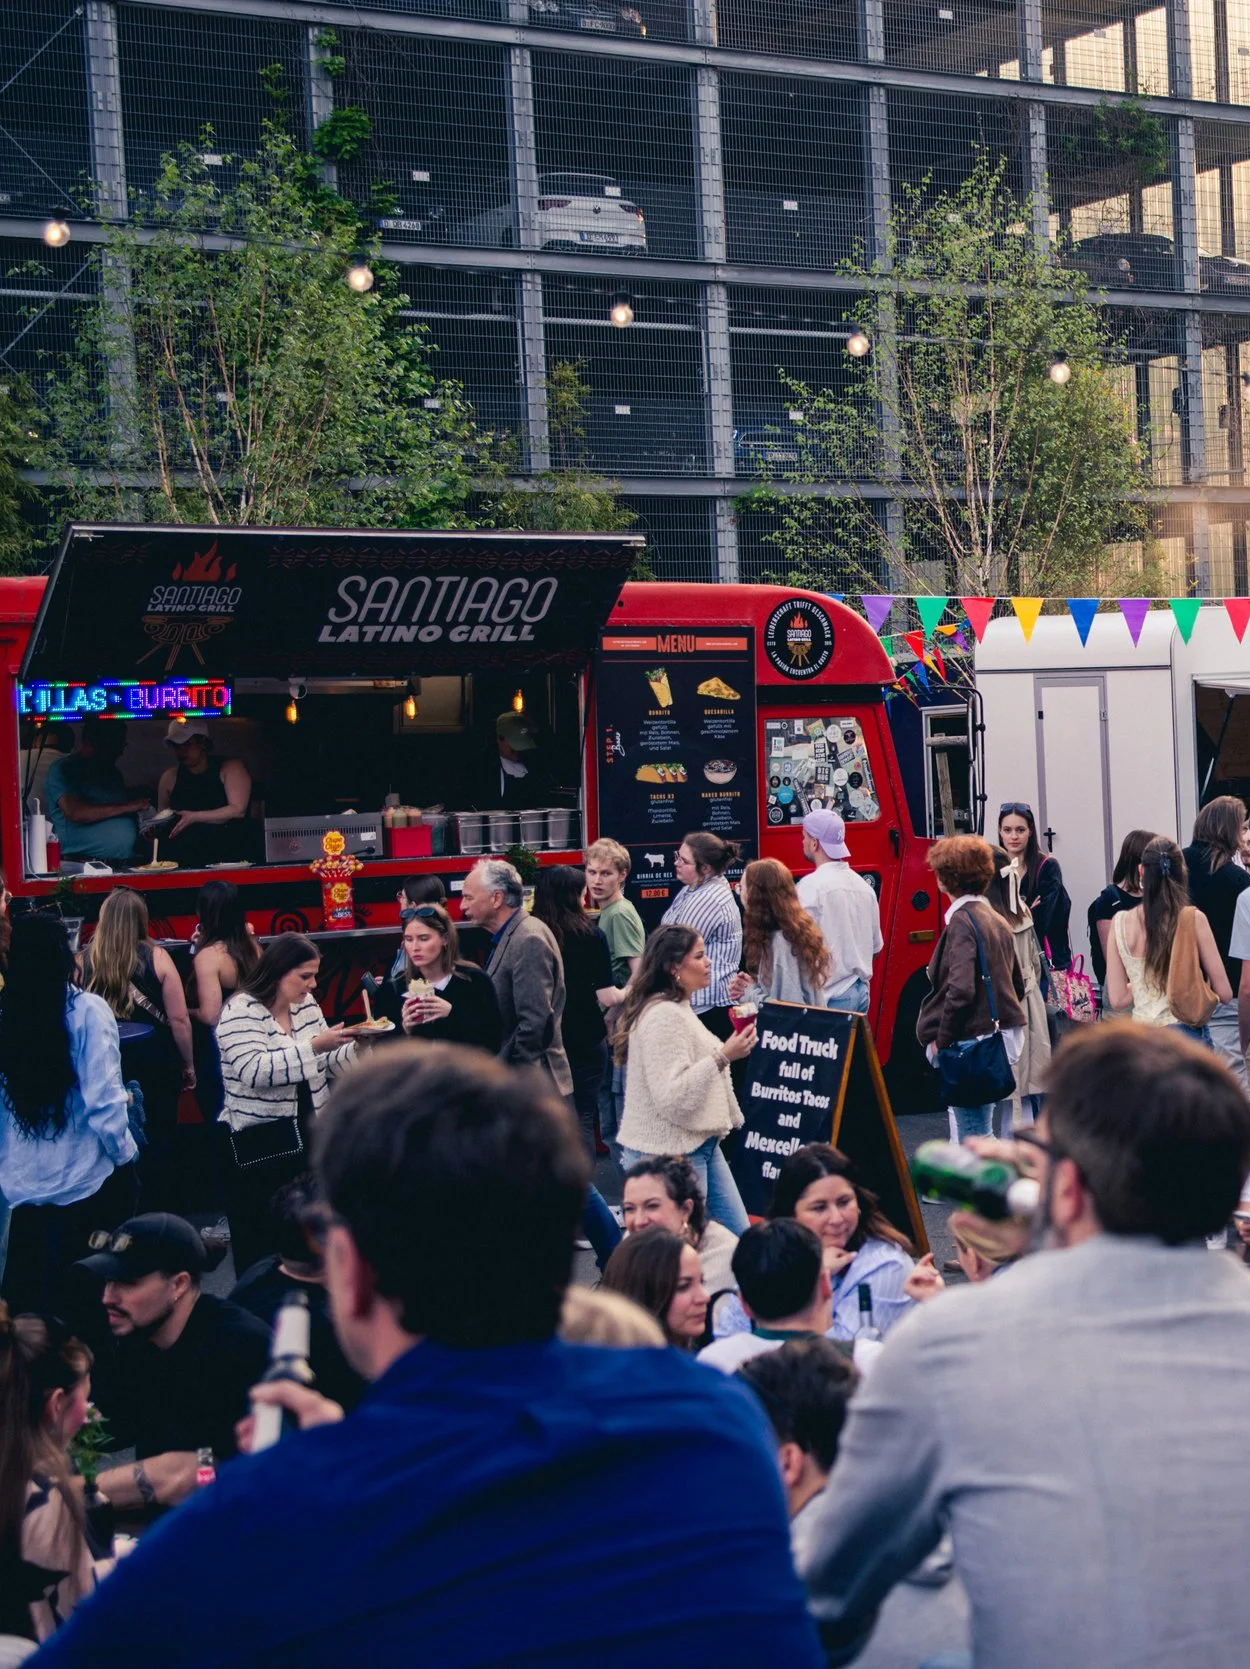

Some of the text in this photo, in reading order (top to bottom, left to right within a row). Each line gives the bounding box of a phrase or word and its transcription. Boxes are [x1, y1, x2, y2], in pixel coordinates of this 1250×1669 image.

[150, 585, 242, 605] SANTIAGO
[327, 575, 559, 624] SANTIAGO
[146, 604, 236, 613] LATINO GRILL
[317, 625, 536, 643] LATINO GRILL
[657, 634, 696, 653] MENU
[786, 629, 812, 638] SANTIAGO
[130, 685, 229, 709] BURRITO
[761, 1030, 839, 1060] Food Truck
[778, 1061, 815, 1081] full of
[751, 1082, 830, 1109] Burritos Tacos
[777, 1112, 802, 1129] and
[744, 1130, 807, 1156] Mexcell
